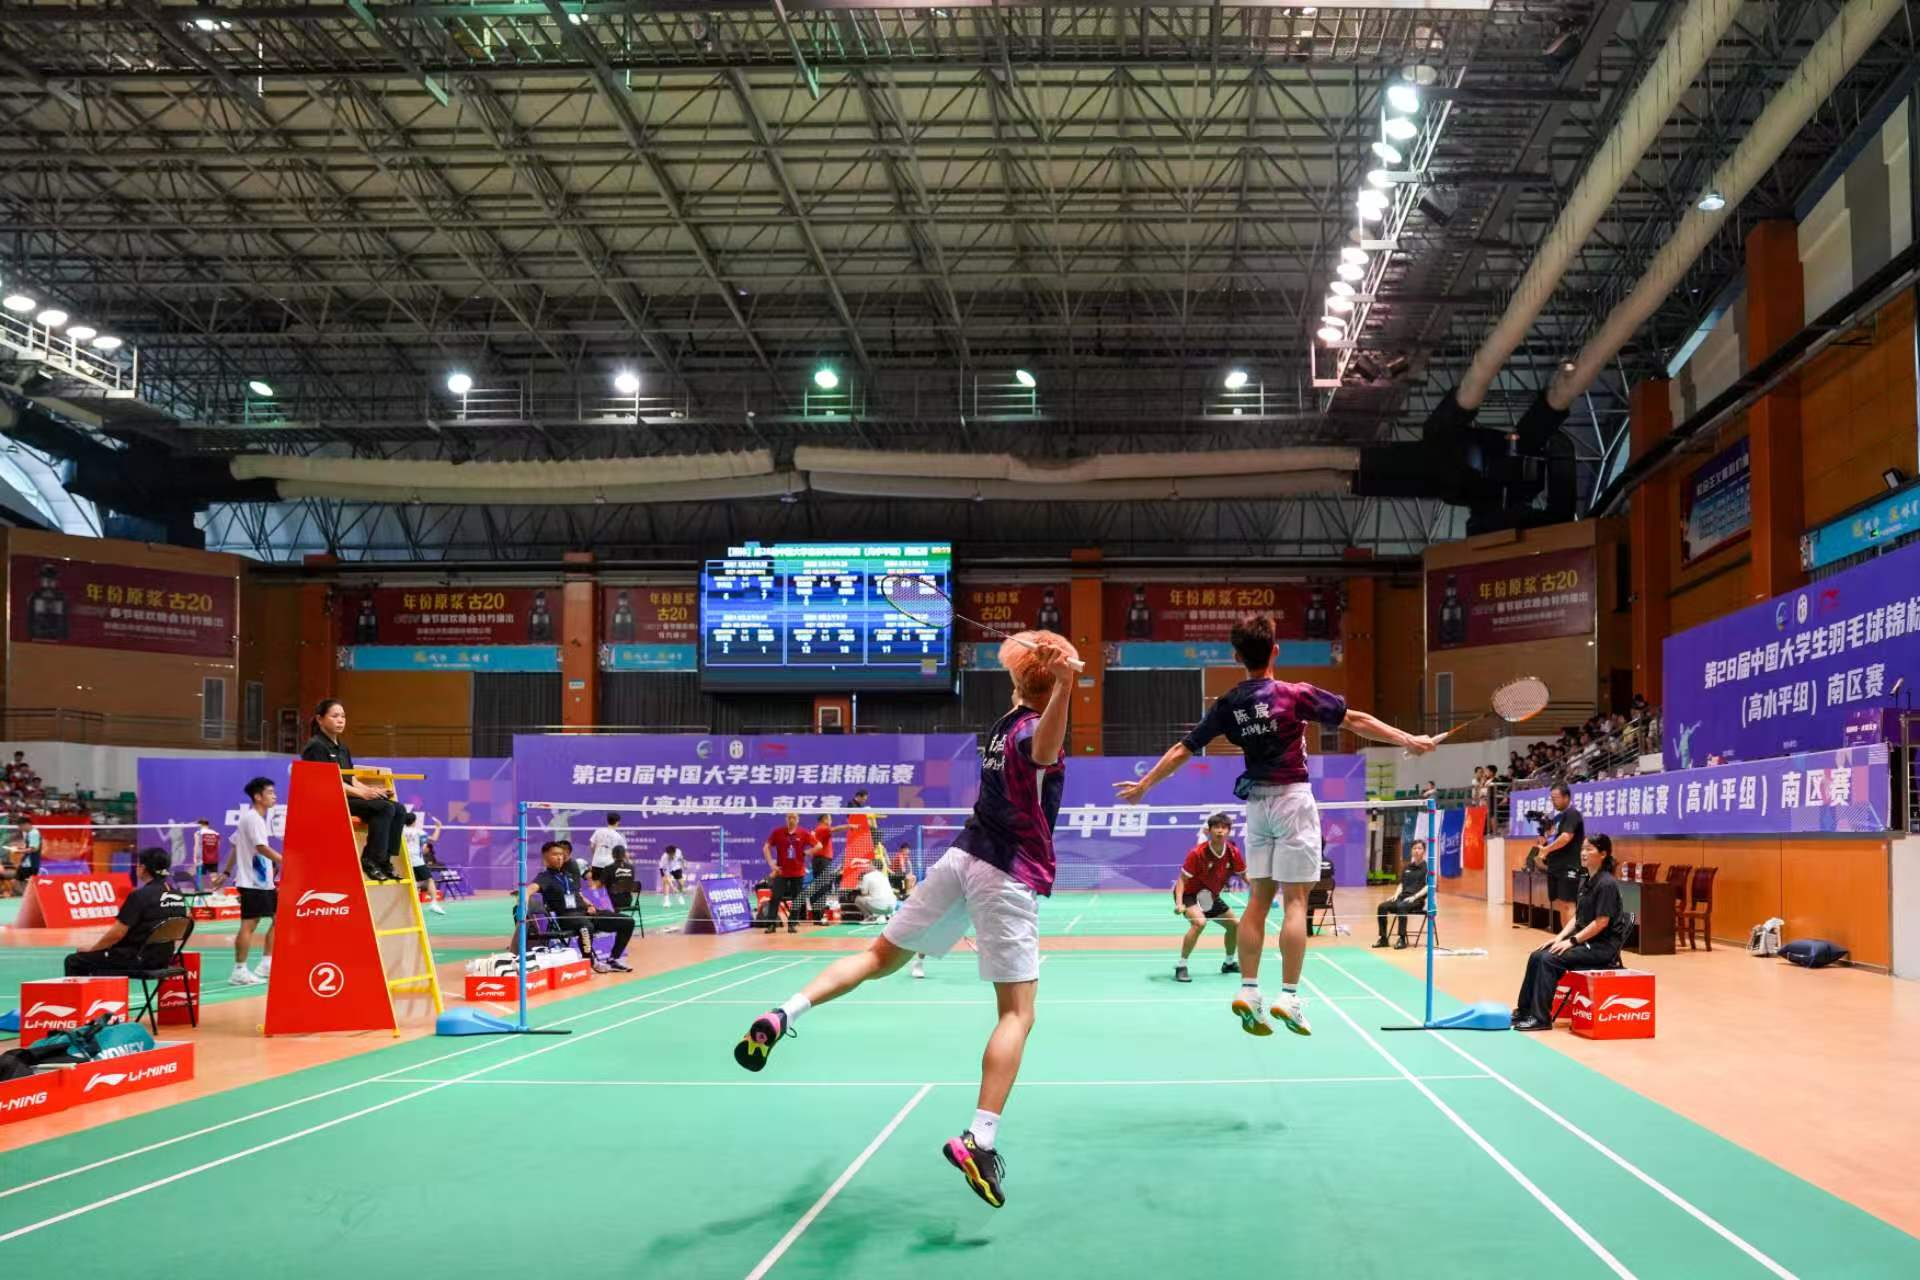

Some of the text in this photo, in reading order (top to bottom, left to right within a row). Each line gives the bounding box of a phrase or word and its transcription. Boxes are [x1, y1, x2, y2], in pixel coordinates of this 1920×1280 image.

[573, 764, 915, 786] 第28届中国大学生羽毛球锦标赛
[63, 880, 116, 905] G600
[296, 906, 350, 917] LI-NING
[318, 969, 336, 991] 2
[24, 1020, 77, 1029] LI-NING
[1598, 1011, 1651, 1022] LI-NING
[127, 1062, 177, 1082] LI-NING
